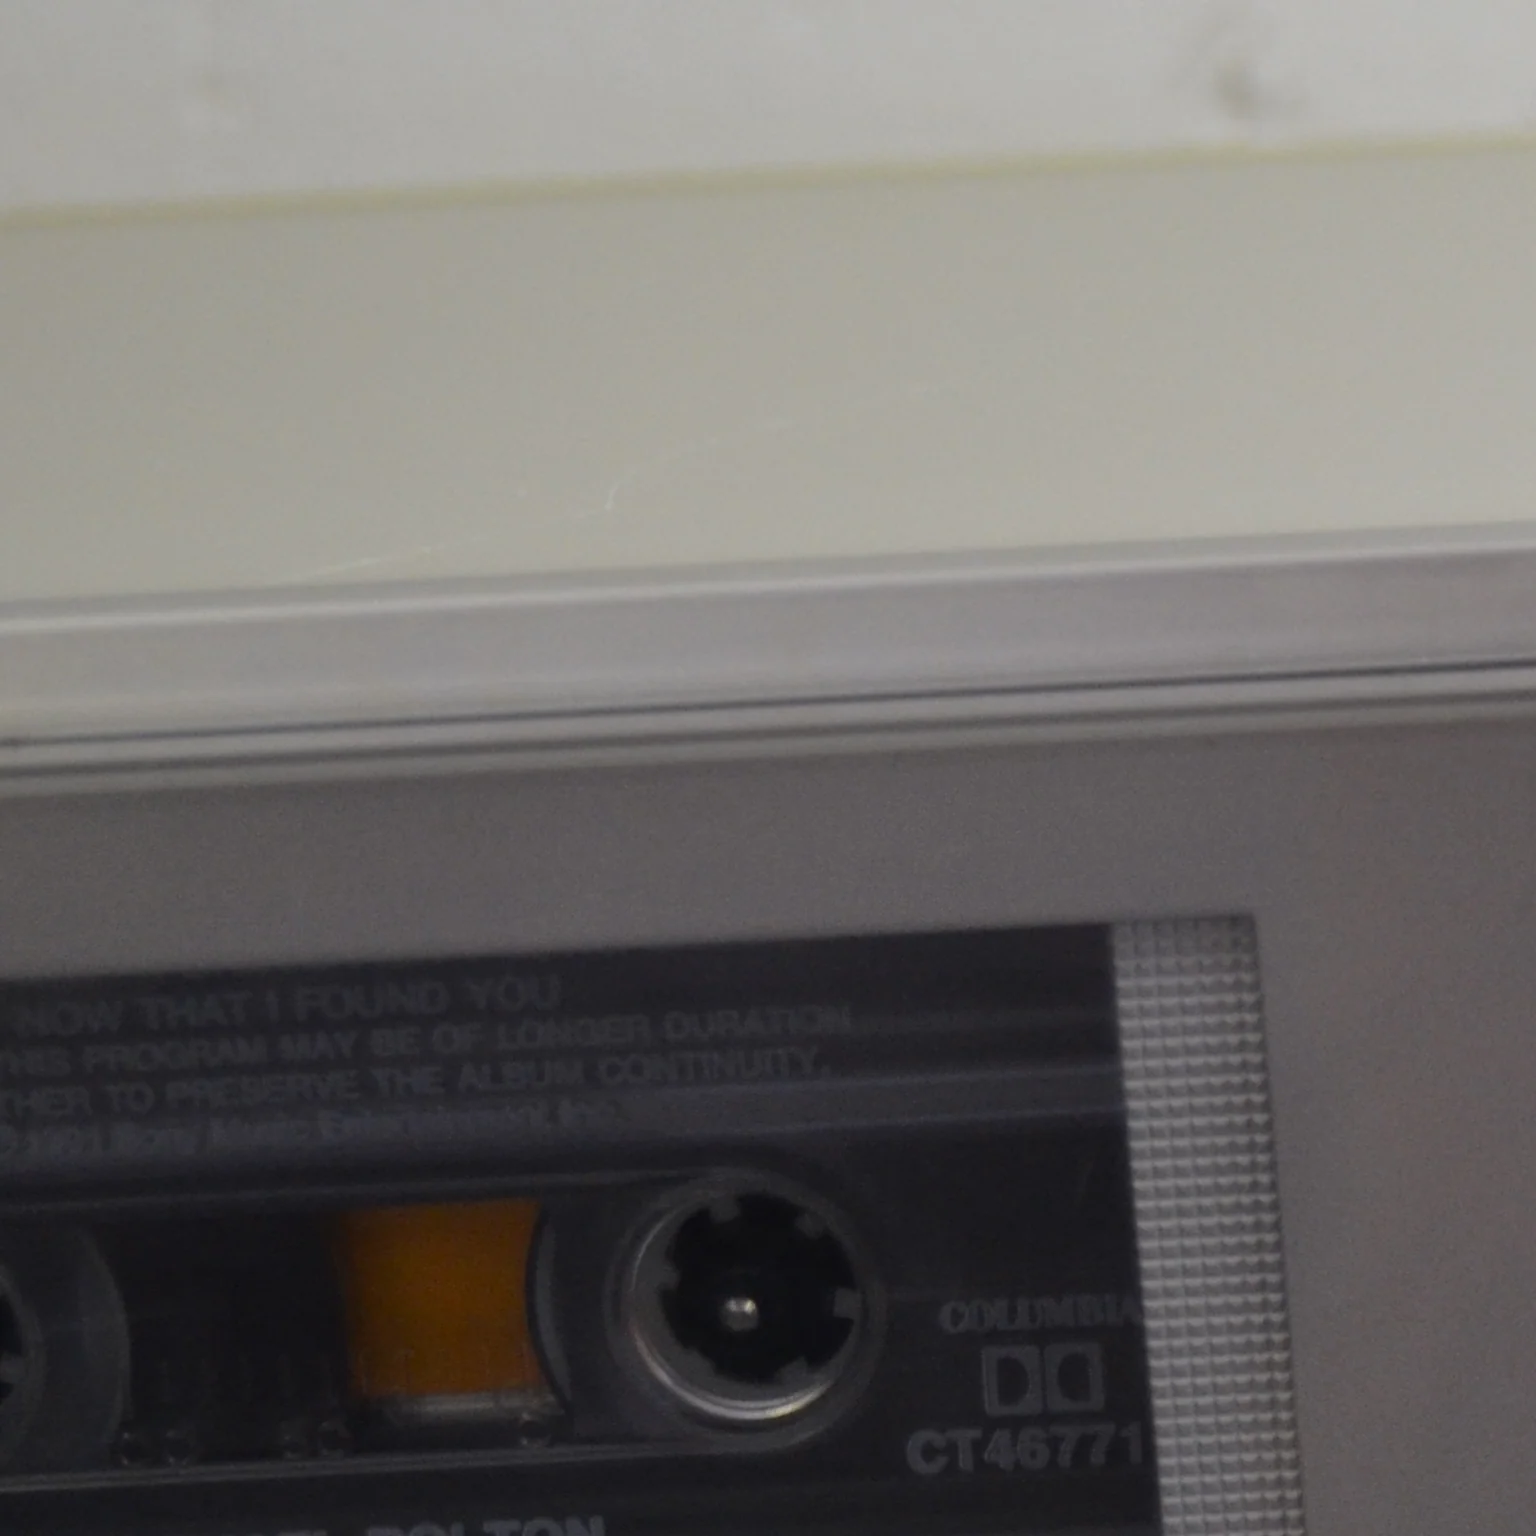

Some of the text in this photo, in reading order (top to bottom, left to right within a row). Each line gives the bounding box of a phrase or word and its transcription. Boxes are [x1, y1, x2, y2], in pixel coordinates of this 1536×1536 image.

[297, 981, 449, 1020] FOUND
[468, 975, 561, 1012] YOU
[281, 1032, 355, 1064] MAY
[430, 1023, 484, 1058] OF
[496, 1015, 650, 1054] LONGER
[663, 1005, 852, 1042] DURATION
[375, 1064, 444, 1098] THE
[458, 1055, 584, 1095] ALBUM
[905, 1421, 1144, 1477] CT46771
